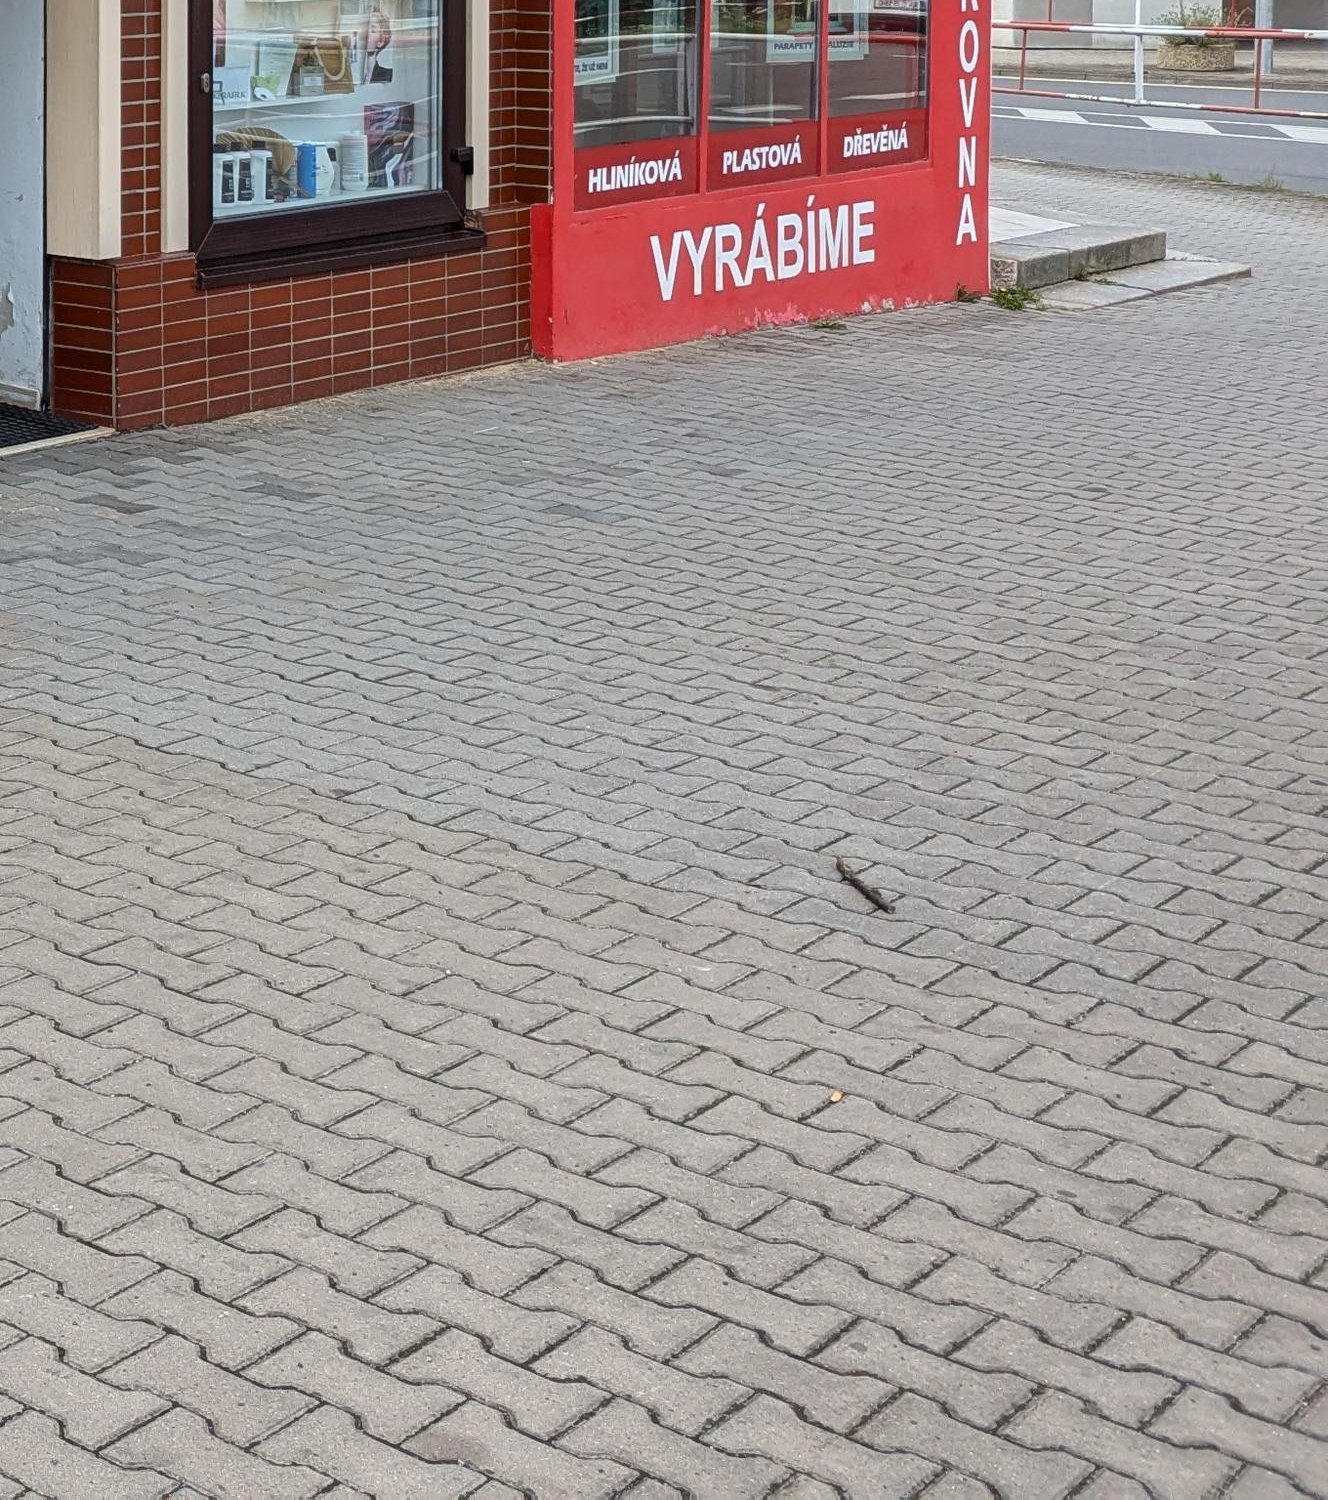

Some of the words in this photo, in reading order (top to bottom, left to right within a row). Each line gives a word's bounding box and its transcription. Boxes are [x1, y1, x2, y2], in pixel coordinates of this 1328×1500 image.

[722, 135, 802, 175] PLASTOVÁ
[843, 121, 909, 158] DŘEVĚNÁ
[588, 150, 682, 194] HLINÍKOVÁ
[649, 194, 876, 302] VYRÁBÍME
